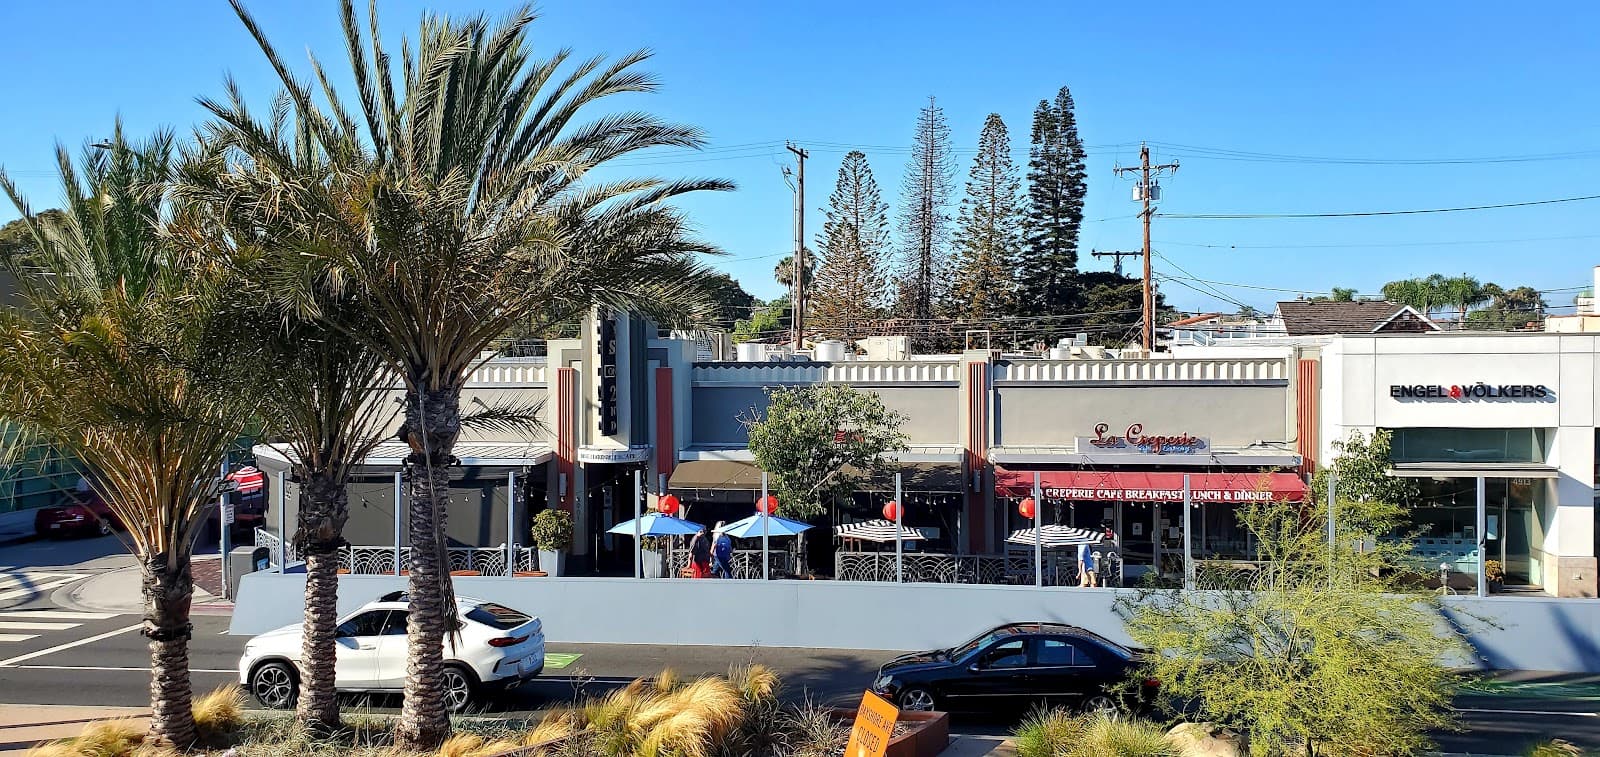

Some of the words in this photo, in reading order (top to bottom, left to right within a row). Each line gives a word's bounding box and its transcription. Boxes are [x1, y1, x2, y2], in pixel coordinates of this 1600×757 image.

[1090, 423, 1118, 445] La
[1126, 423, 1196, 453] Creperie
[1125, 489, 1184, 500] BREAKFAST
[1189, 490, 1221, 501] UNCH
[1223, 490, 1232, 500] &
[857, 726, 880, 752] CLOSED
